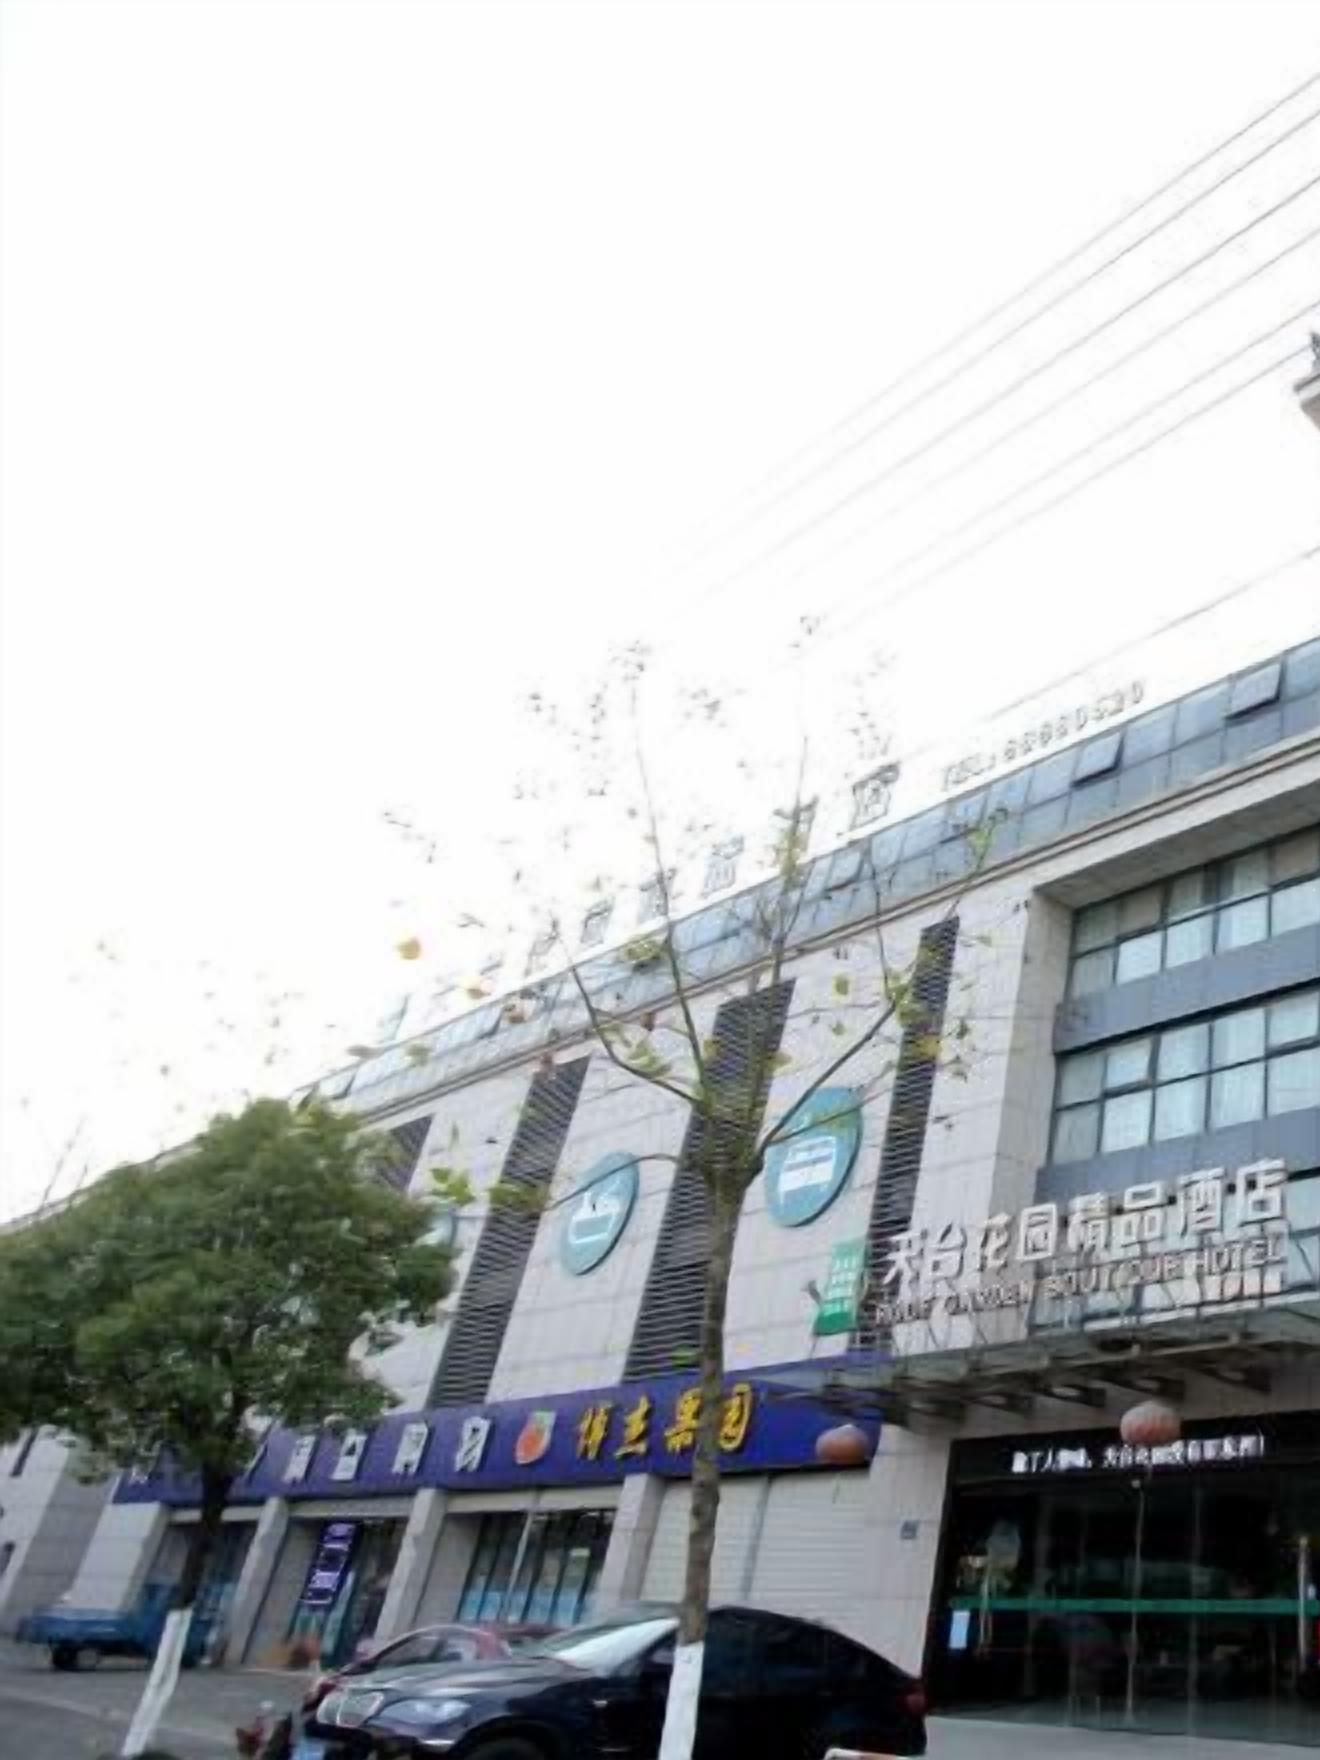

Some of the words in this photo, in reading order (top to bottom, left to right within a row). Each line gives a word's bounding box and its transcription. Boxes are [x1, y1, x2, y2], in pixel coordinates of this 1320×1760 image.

[883, 1157, 1287, 1283] 天台花园精品酒店
[1185, 1238, 1281, 1275] HOTEL
